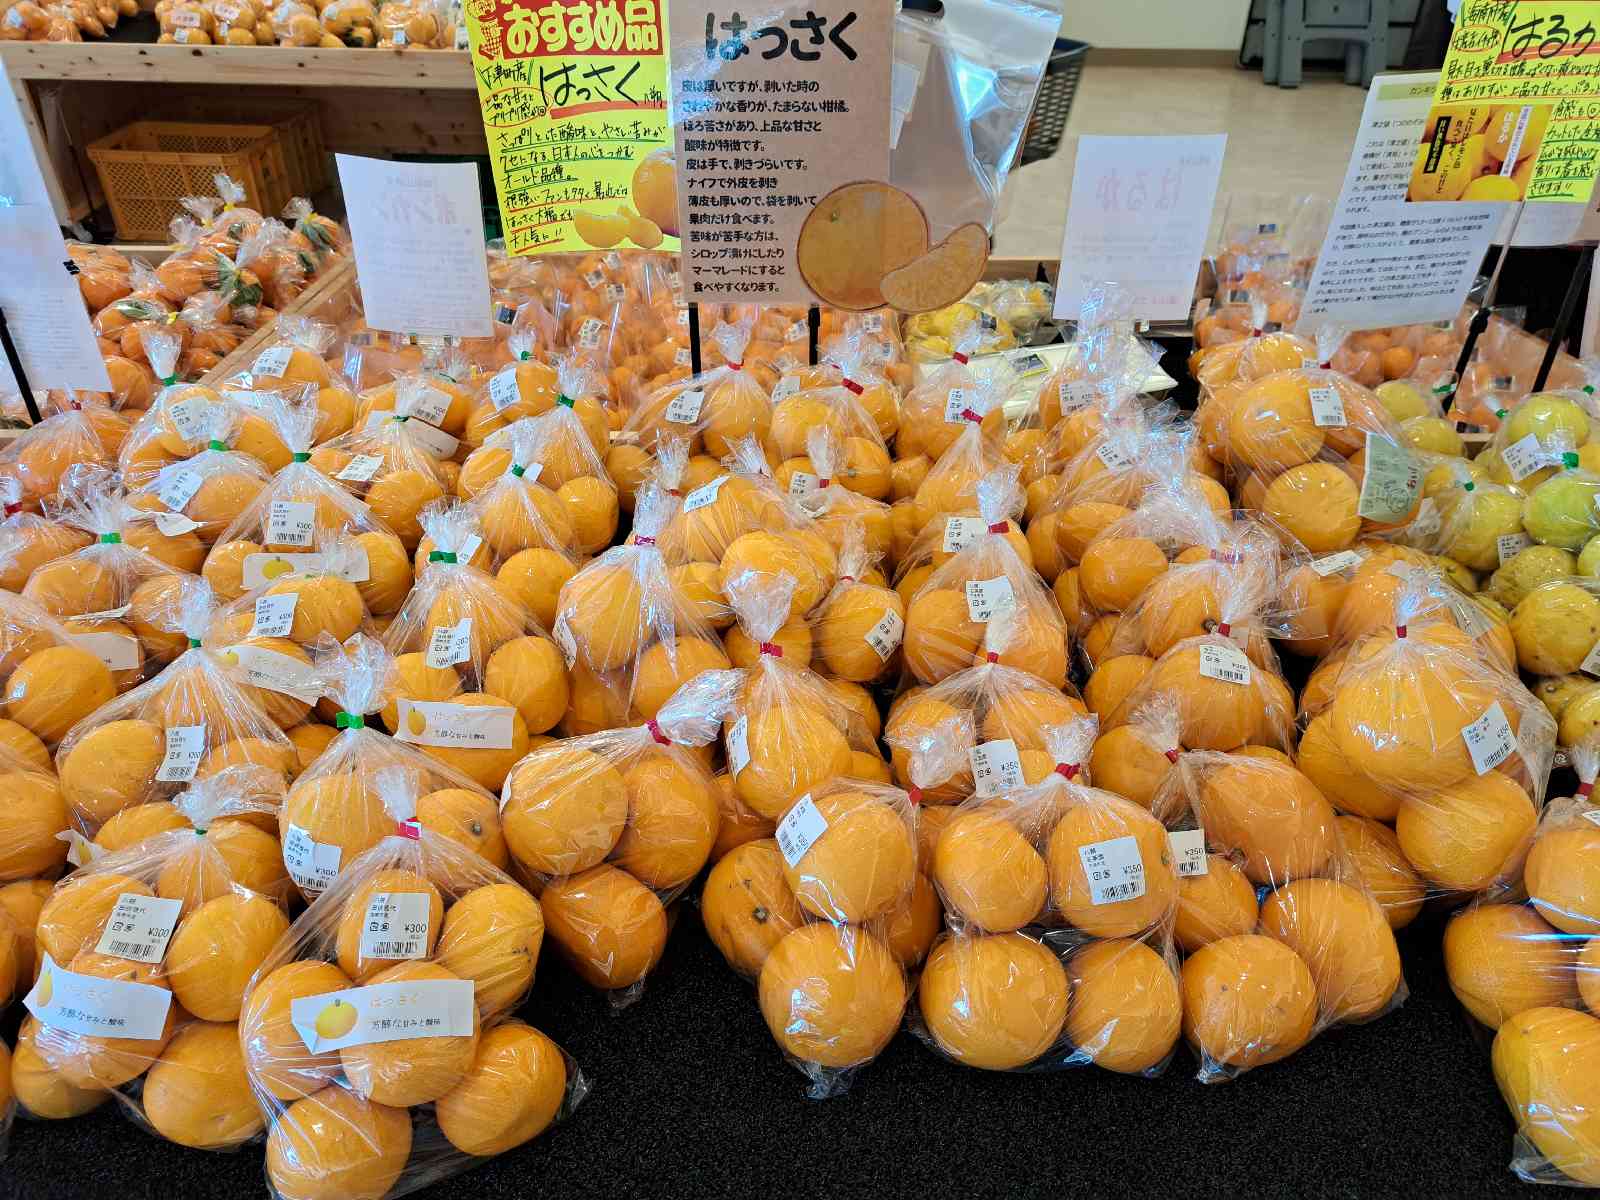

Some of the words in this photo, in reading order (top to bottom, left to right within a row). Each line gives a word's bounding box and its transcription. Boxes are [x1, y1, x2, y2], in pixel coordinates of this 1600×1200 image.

[503, 0, 659, 54] おすすめ品
[706, 11, 857, 61] はっさく
[540, 61, 640, 106] はっさく
[683, 120, 822, 132] ほろ苦さがあり、上品な甘さと
[684, 139, 765, 151] 酸味が特徴です。
[686, 159, 808, 170] 皮は手で、剥きづらいです。
[687, 177, 777, 189] ナイフで外皮を剥き
[688, 195, 816, 207] 薄皮も厚いので、袋を剥いて
[688, 212, 774, 225] 果肉だけ食べます。
[690, 230, 779, 242] 苦味が苦手な方は、
[691, 248, 784, 259] シロップ漬けにしたり
[692, 265, 785, 276] マーマレードにすると
[693, 282, 780, 293] 食べやすくなります。
[1122, 864, 1142, 874] ¥350
[148, 926, 170, 938] ¥300
[404, 923, 427, 934] ¥300
